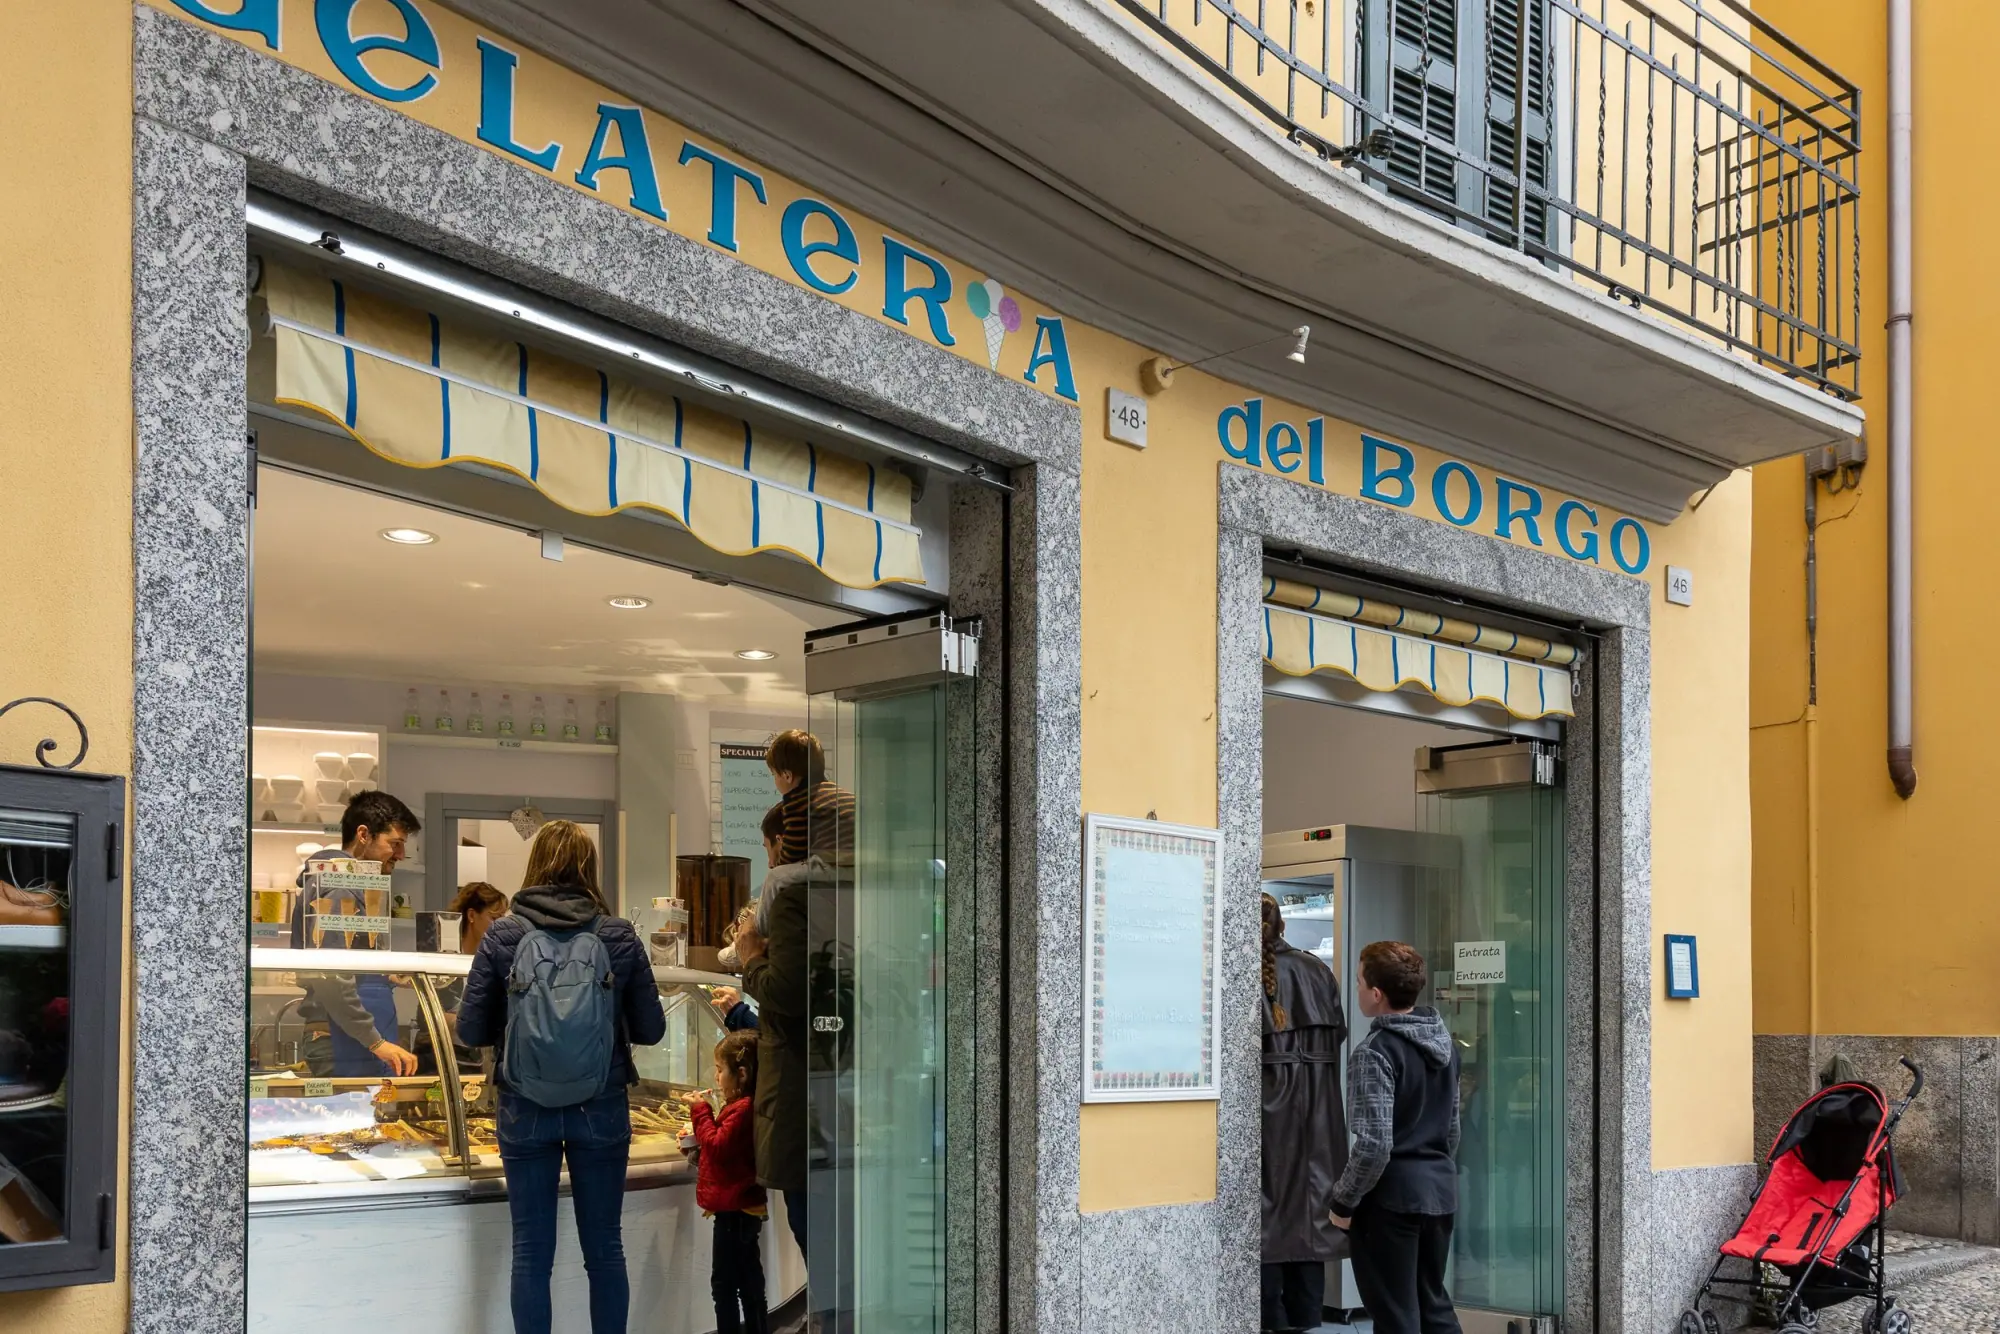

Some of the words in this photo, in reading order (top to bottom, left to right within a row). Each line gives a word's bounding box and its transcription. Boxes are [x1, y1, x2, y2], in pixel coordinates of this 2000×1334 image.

[1217, 397, 1325, 485] del
[1359, 432, 1652, 574] BORGO
[1673, 577, 1688, 594] 46
[1458, 946, 1500, 958] Entrata
[1456, 970, 1504, 981] Entrance
